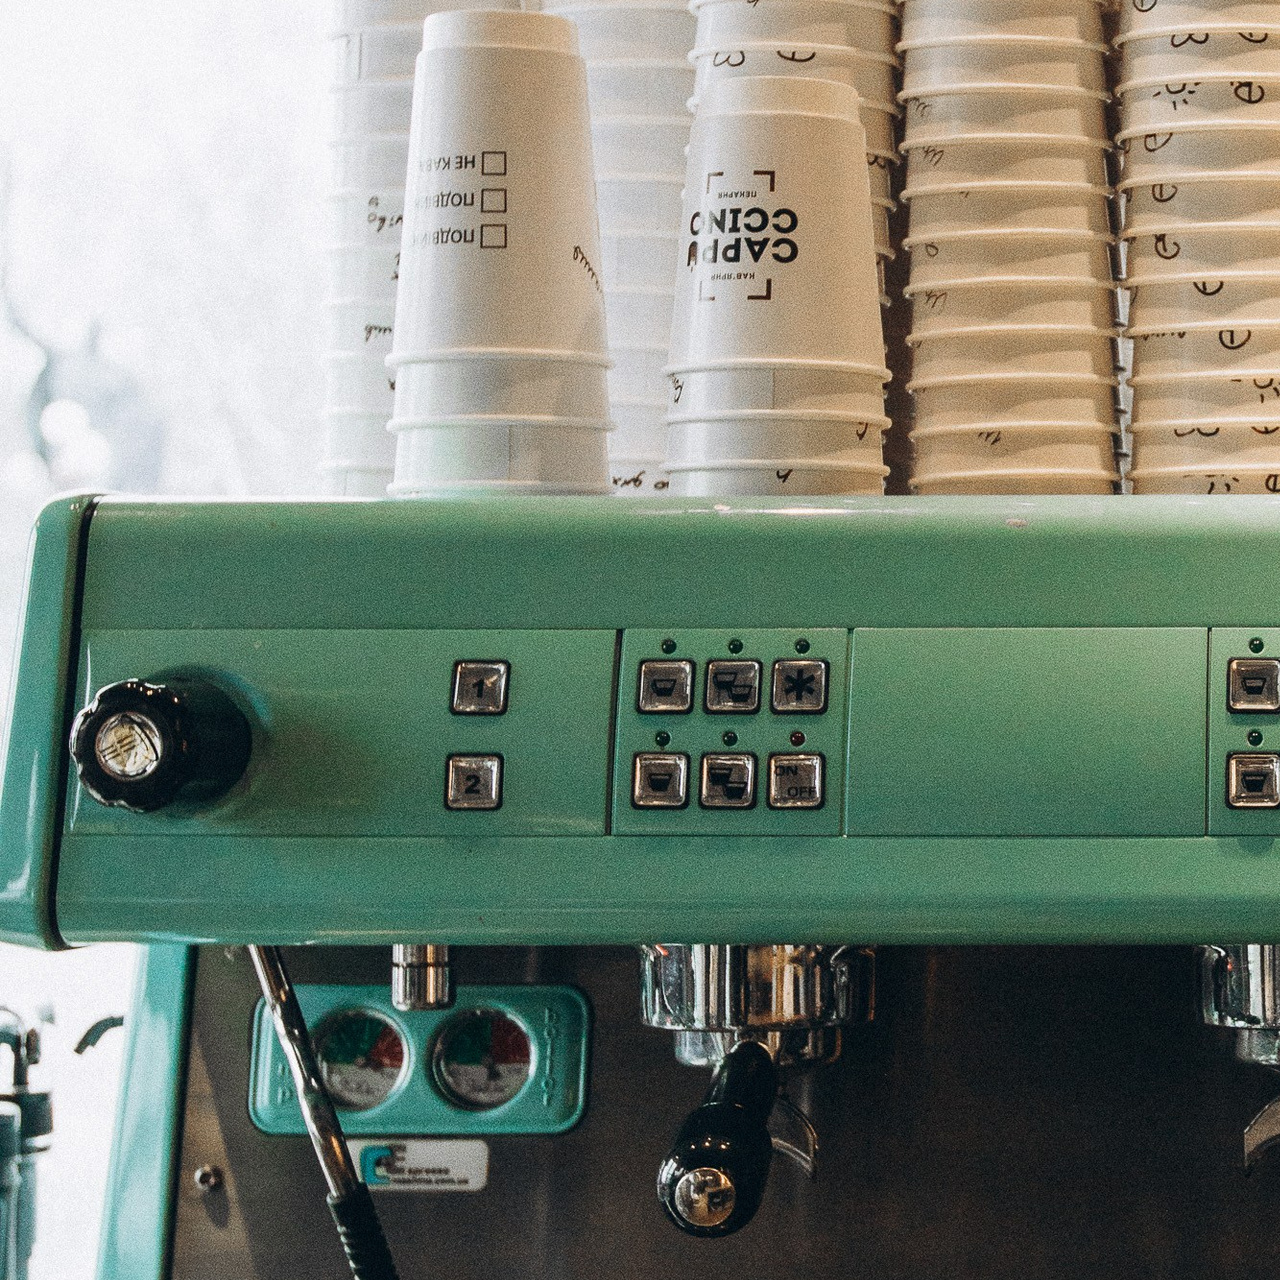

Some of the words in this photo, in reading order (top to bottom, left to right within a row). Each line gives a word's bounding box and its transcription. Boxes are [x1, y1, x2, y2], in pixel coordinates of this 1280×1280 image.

[455, 155, 476, 170] НЕ
[717, 190, 757, 199] ПЕКАРНЯ
[689, 207, 799, 236] CCINO
[472, 679, 484, 698] 1
[775, 765, 798, 777] ON
[465, 774, 481, 794] 2
[787, 786, 816, 798] OFF
